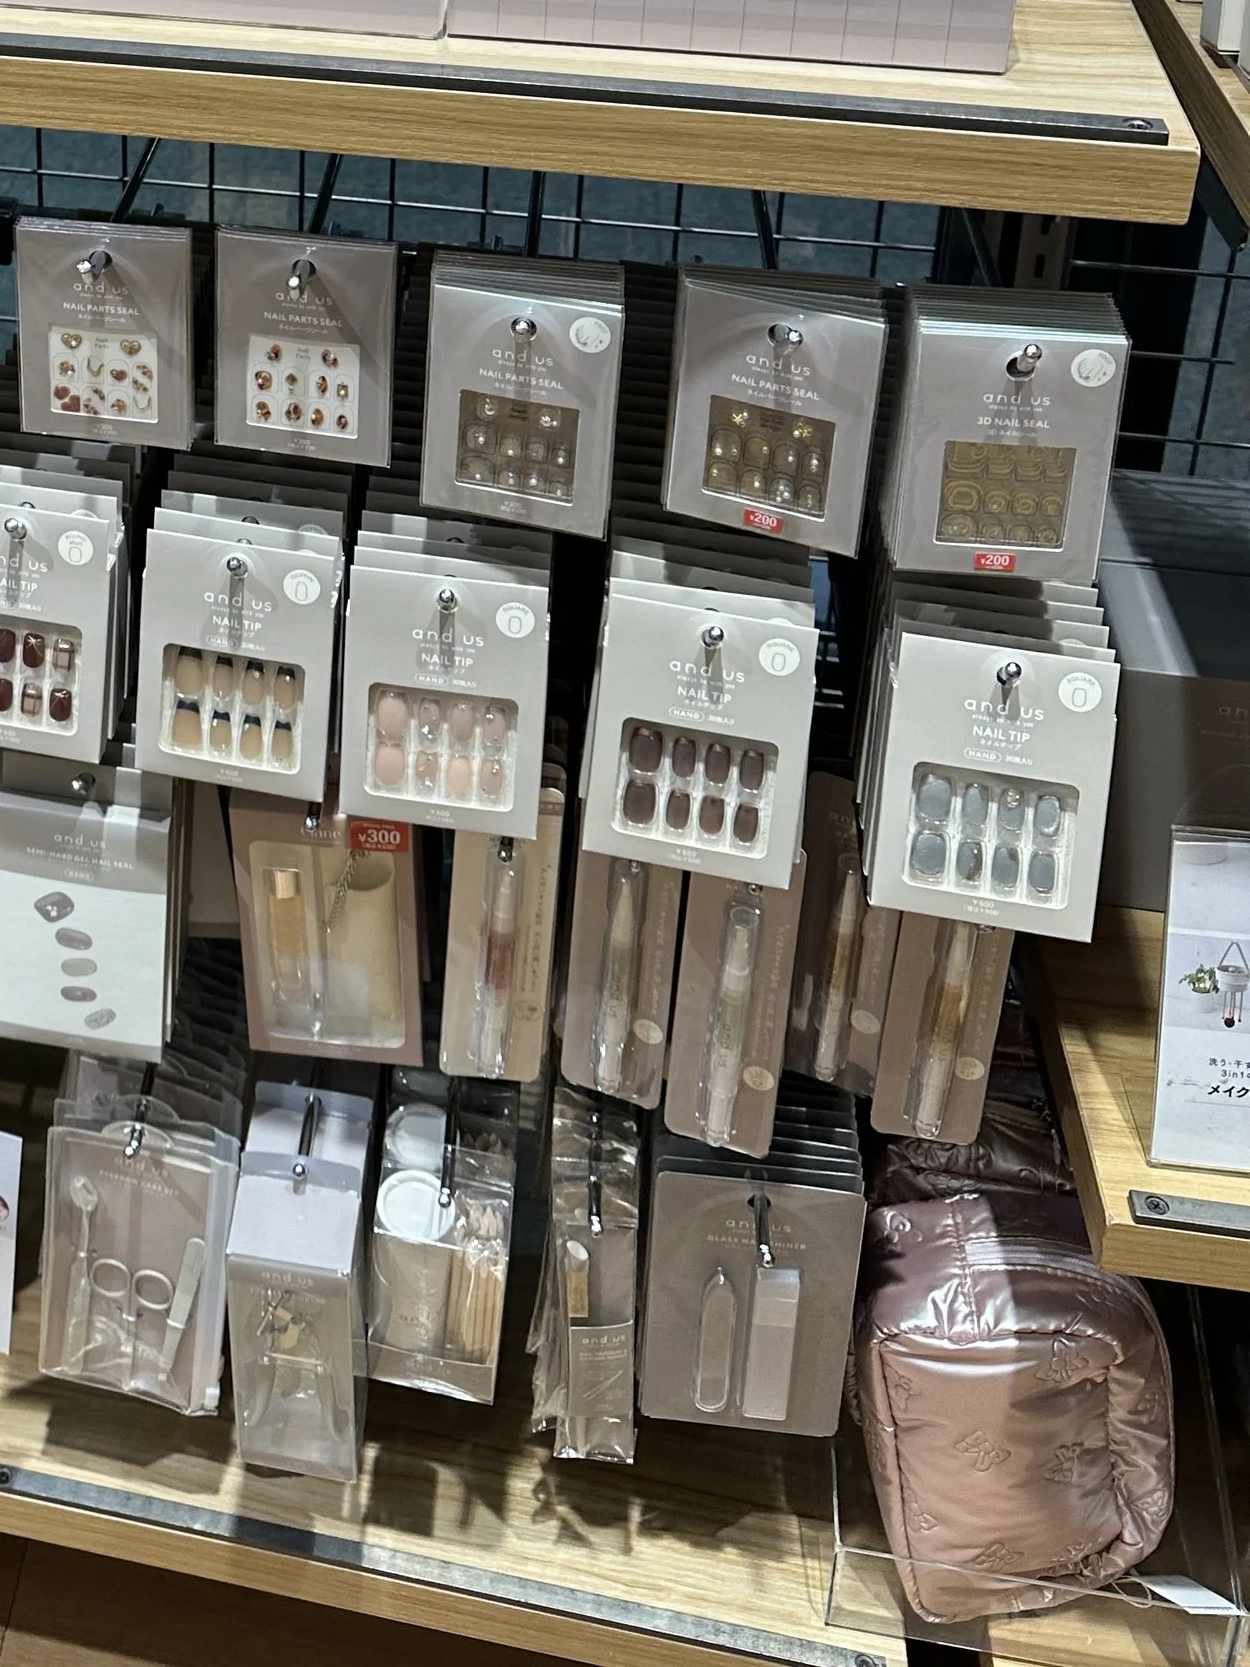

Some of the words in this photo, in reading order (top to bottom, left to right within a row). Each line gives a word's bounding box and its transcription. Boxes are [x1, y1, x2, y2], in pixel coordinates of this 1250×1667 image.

[72, 280, 105, 294] and
[63, 301, 86, 313] NAIL
[87, 303, 115, 315] PARTS
[116, 306, 141, 317] SEAL
[263, 310, 287, 321] NAIL
[288, 312, 317, 325] PARTS
[318, 317, 344, 328] SEAL
[491, 348, 527, 363] and
[745, 353, 783, 370] and
[478, 367, 504, 380] NAIL
[505, 371, 535, 386] PARTS
[536, 378, 564, 391] SEAL
[731, 372, 757, 386] NAIL
[758, 379, 792, 395] PARTS
[792, 387, 819, 401] SEAL
[982, 392, 1022, 405] and
[976, 415, 992, 425] 3D
[993, 417, 1020, 427] NAIL
[1022, 418, 1050, 429] SEAL
[748, 512, 778, 528] ¥200
[27, 559, 48, 573] us
[980, 552, 1010, 566] ¥200
[20, 580, 39, 592] TIP
[203, 592, 243, 608] and
[250, 599, 273, 613] us
[212, 614, 241, 629] NAIL
[242, 619, 262, 632] TIP
[411, 627, 454, 643] and
[461, 634, 484, 647] us
[420, 652, 451, 666] NAIL
[453, 656, 474, 669] TIP
[419, 675, 445, 685] HAND
[669, 661, 713, 677] and
[721, 669, 746, 684] us
[677, 685, 708, 700] NAIL
[709, 690, 733, 704] TIP
[673, 709, 700, 720] HAND
[963, 698, 1010, 716] and
[1020, 705, 1045, 721] us
[971, 724, 1007, 741] NAIL
[1008, 729, 1031, 744] TIP
[967, 750, 997, 761] HAND
[358, 828, 401, 846] ¥300
